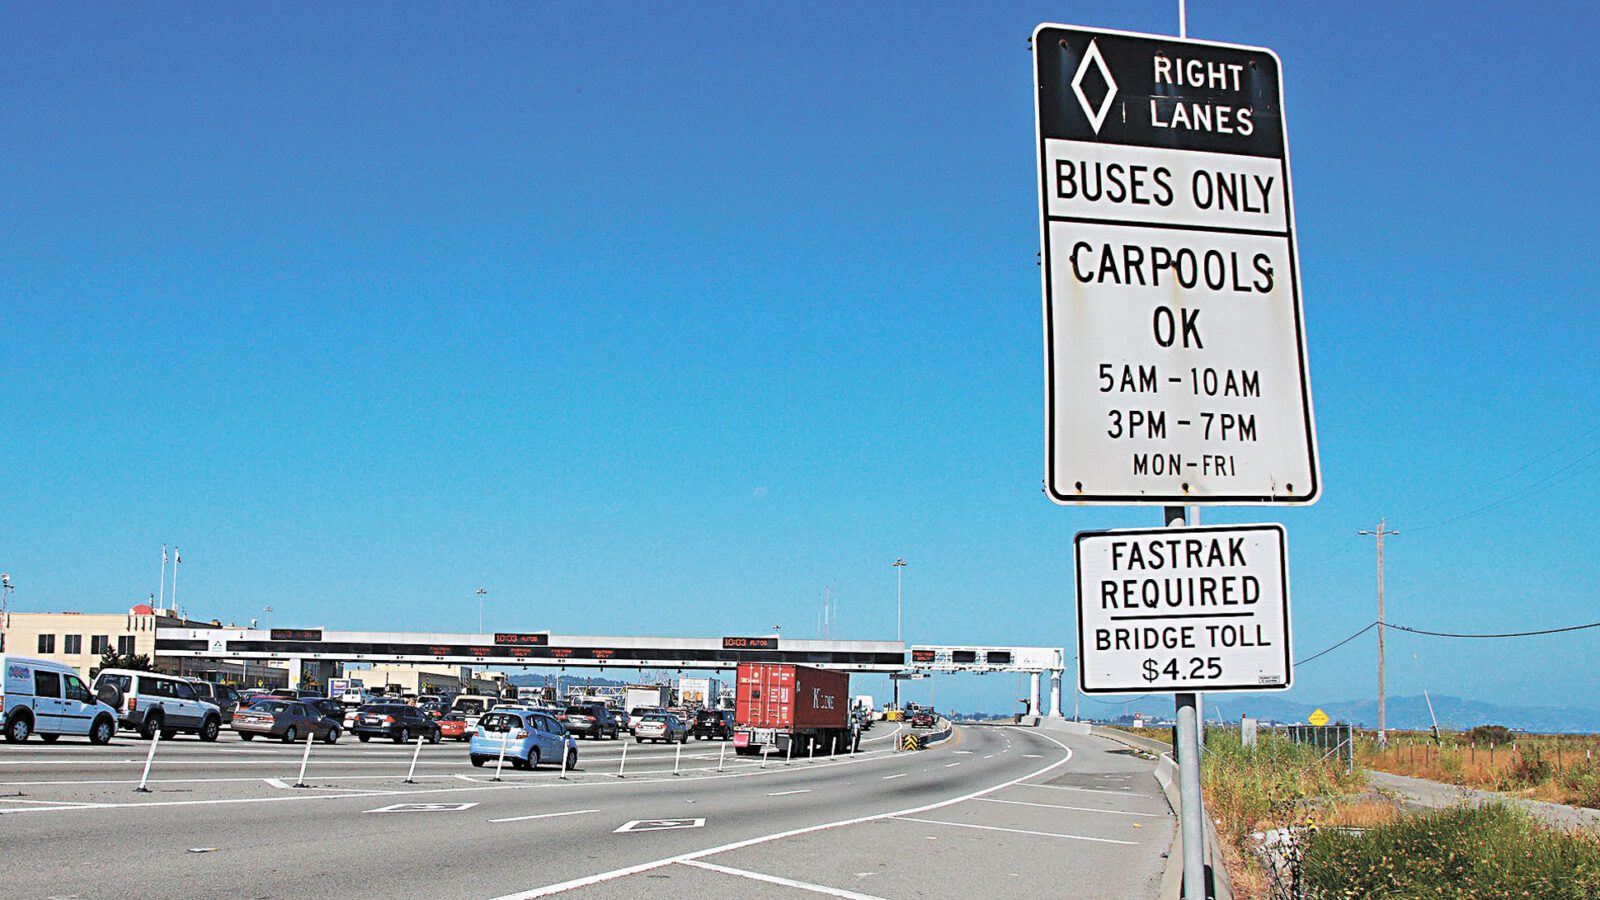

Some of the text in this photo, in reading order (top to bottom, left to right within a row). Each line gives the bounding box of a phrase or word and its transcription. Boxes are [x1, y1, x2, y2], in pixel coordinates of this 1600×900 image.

[1154, 56, 1243, 92] RIGHT
[1150, 99, 1255, 136] LANES
[1055, 159, 1274, 214] BUSES ONLY
[1070, 241, 1274, 294] CARPOOLS
[1153, 305, 1204, 349] OK
[1099, 363, 1158, 393] 5AM
[1190, 367, 1261, 398] 10AM
[1107, 409, 1167, 439] 3PM
[1200, 412, 1257, 442] 7PM
[1111, 537, 1247, 571] FASTRAK
[1101, 575, 1260, 609] REQUIRED
[496, 634, 518, 643] 10:03
[724, 639, 747, 647] 10:03
[1095, 624, 1272, 651] BRIDGE TOLL
[1142, 656, 1223, 684] $4.25
